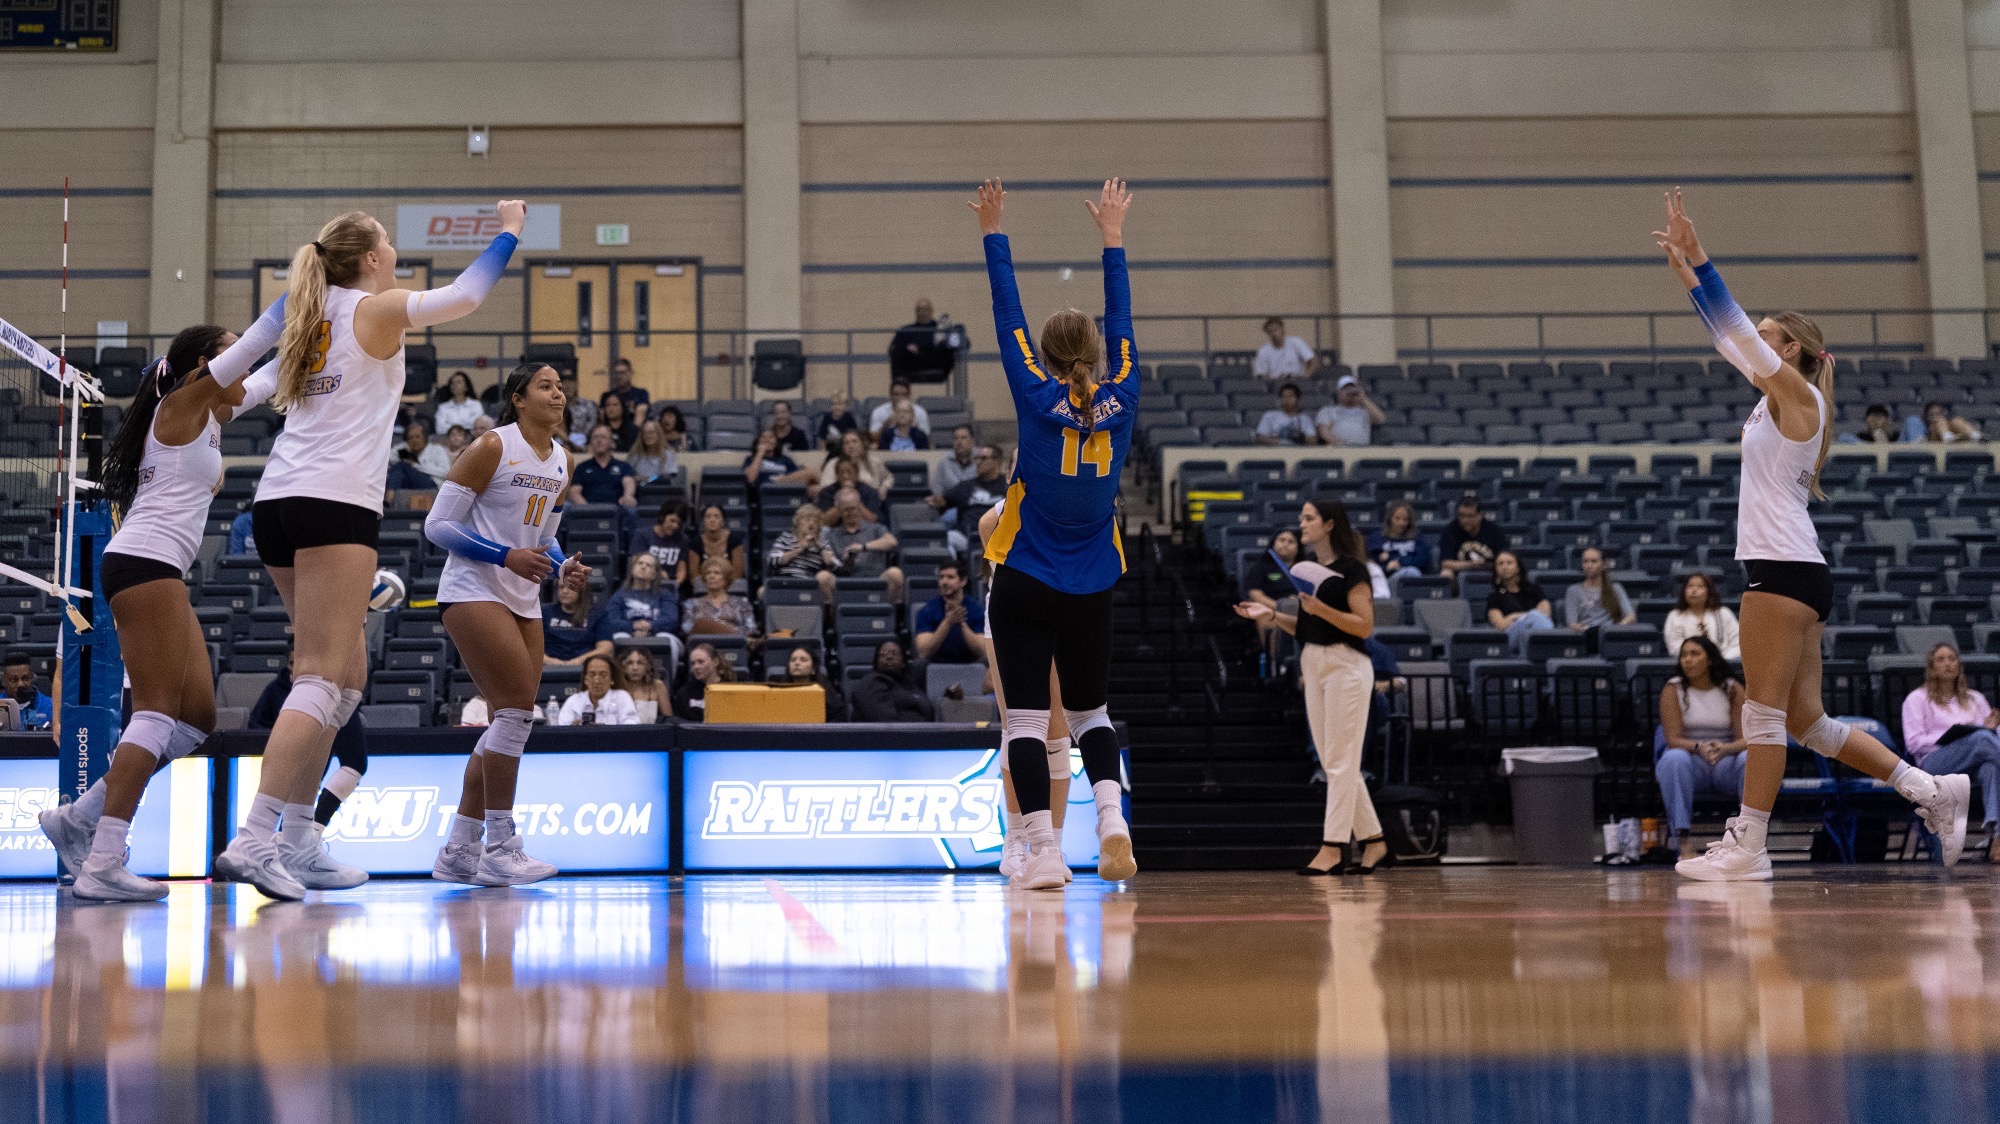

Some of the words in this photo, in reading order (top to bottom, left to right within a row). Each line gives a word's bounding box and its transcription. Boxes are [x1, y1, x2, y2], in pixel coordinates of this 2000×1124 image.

[428, 215, 504, 236] DETE
[1061, 427, 1113, 477] 14
[524, 494, 547, 527] 11
[76, 727, 89, 768] sports
[437, 801, 652, 836] TETS.COM
[704, 782, 997, 837] RATTLERS
[0, 834, 56, 850] ARYS
